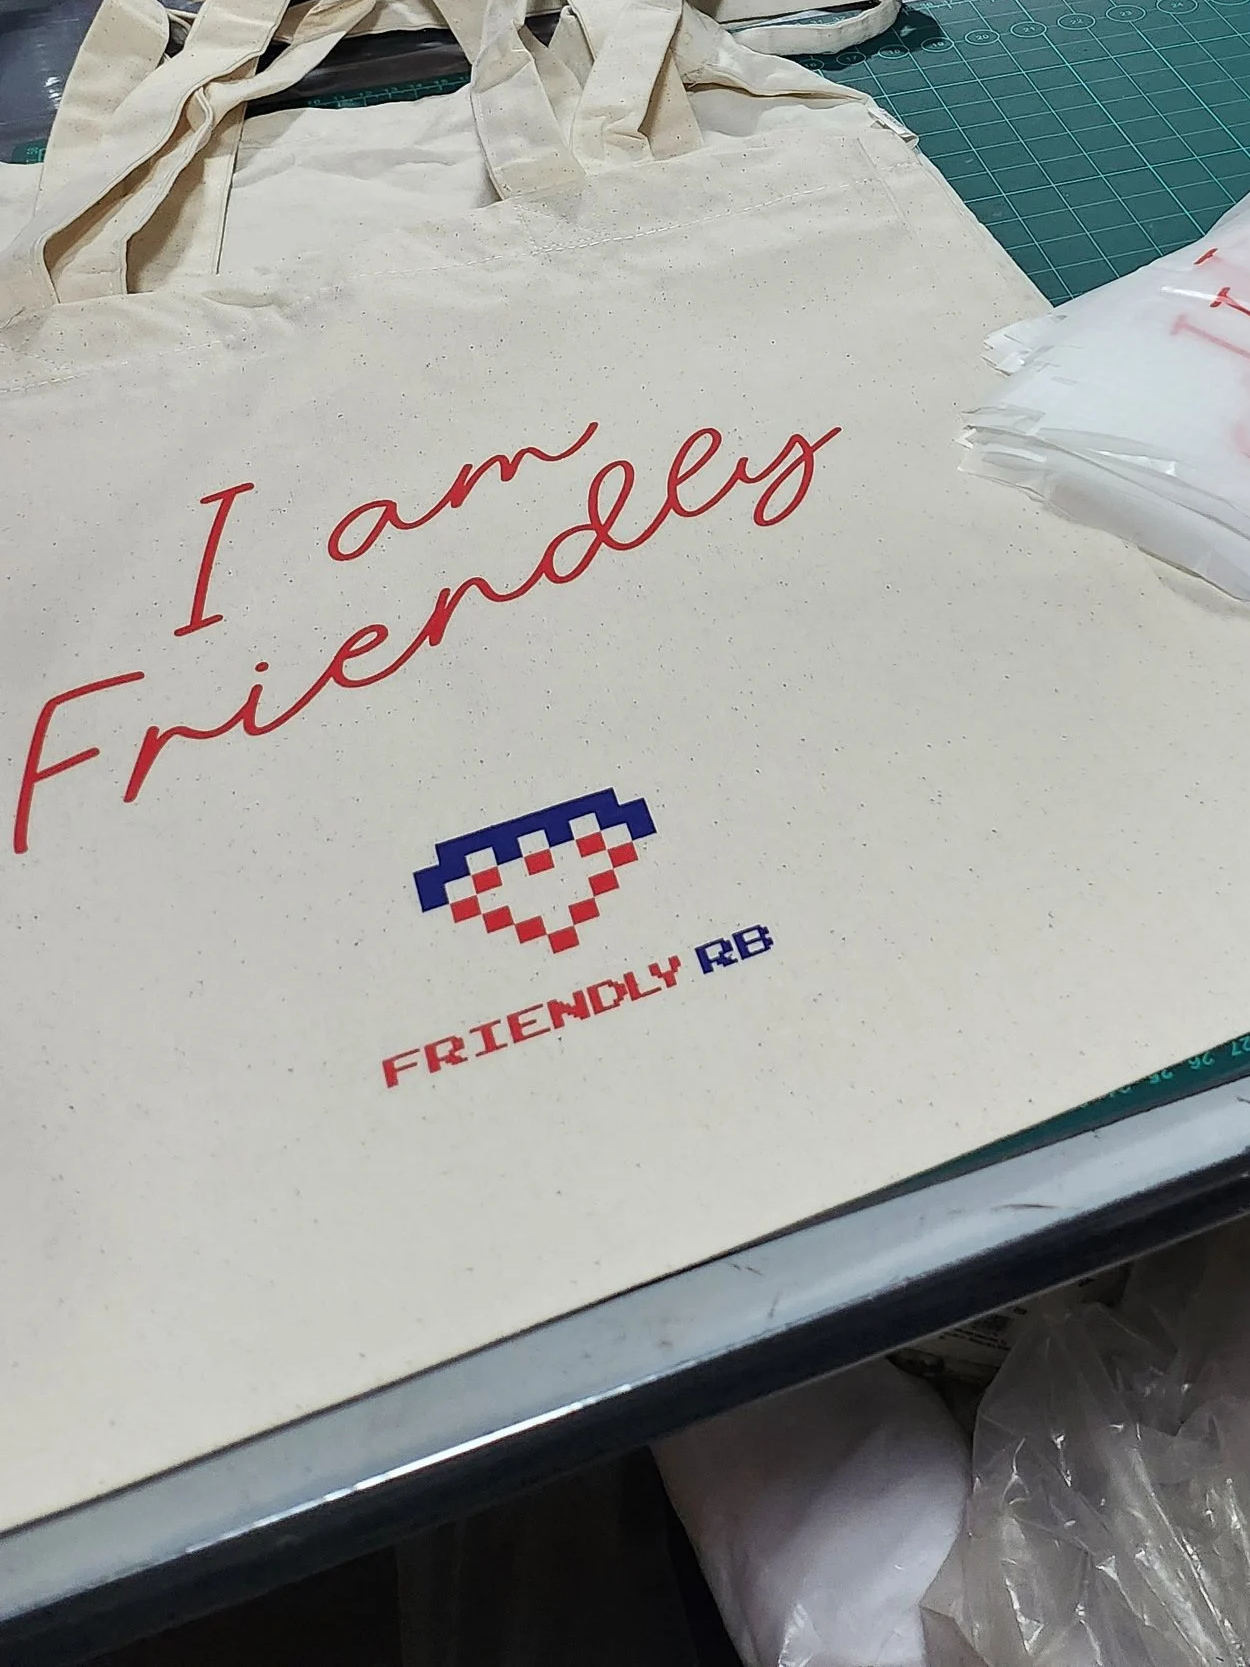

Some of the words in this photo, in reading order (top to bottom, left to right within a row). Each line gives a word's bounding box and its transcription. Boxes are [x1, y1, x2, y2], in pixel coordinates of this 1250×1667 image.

[174, 481, 255, 637] I
[328, 421, 599, 562] am
[13, 426, 842, 855] Friendly
[382, 955, 682, 1089] FRIENDLY
[694, 924, 775, 975] RB
